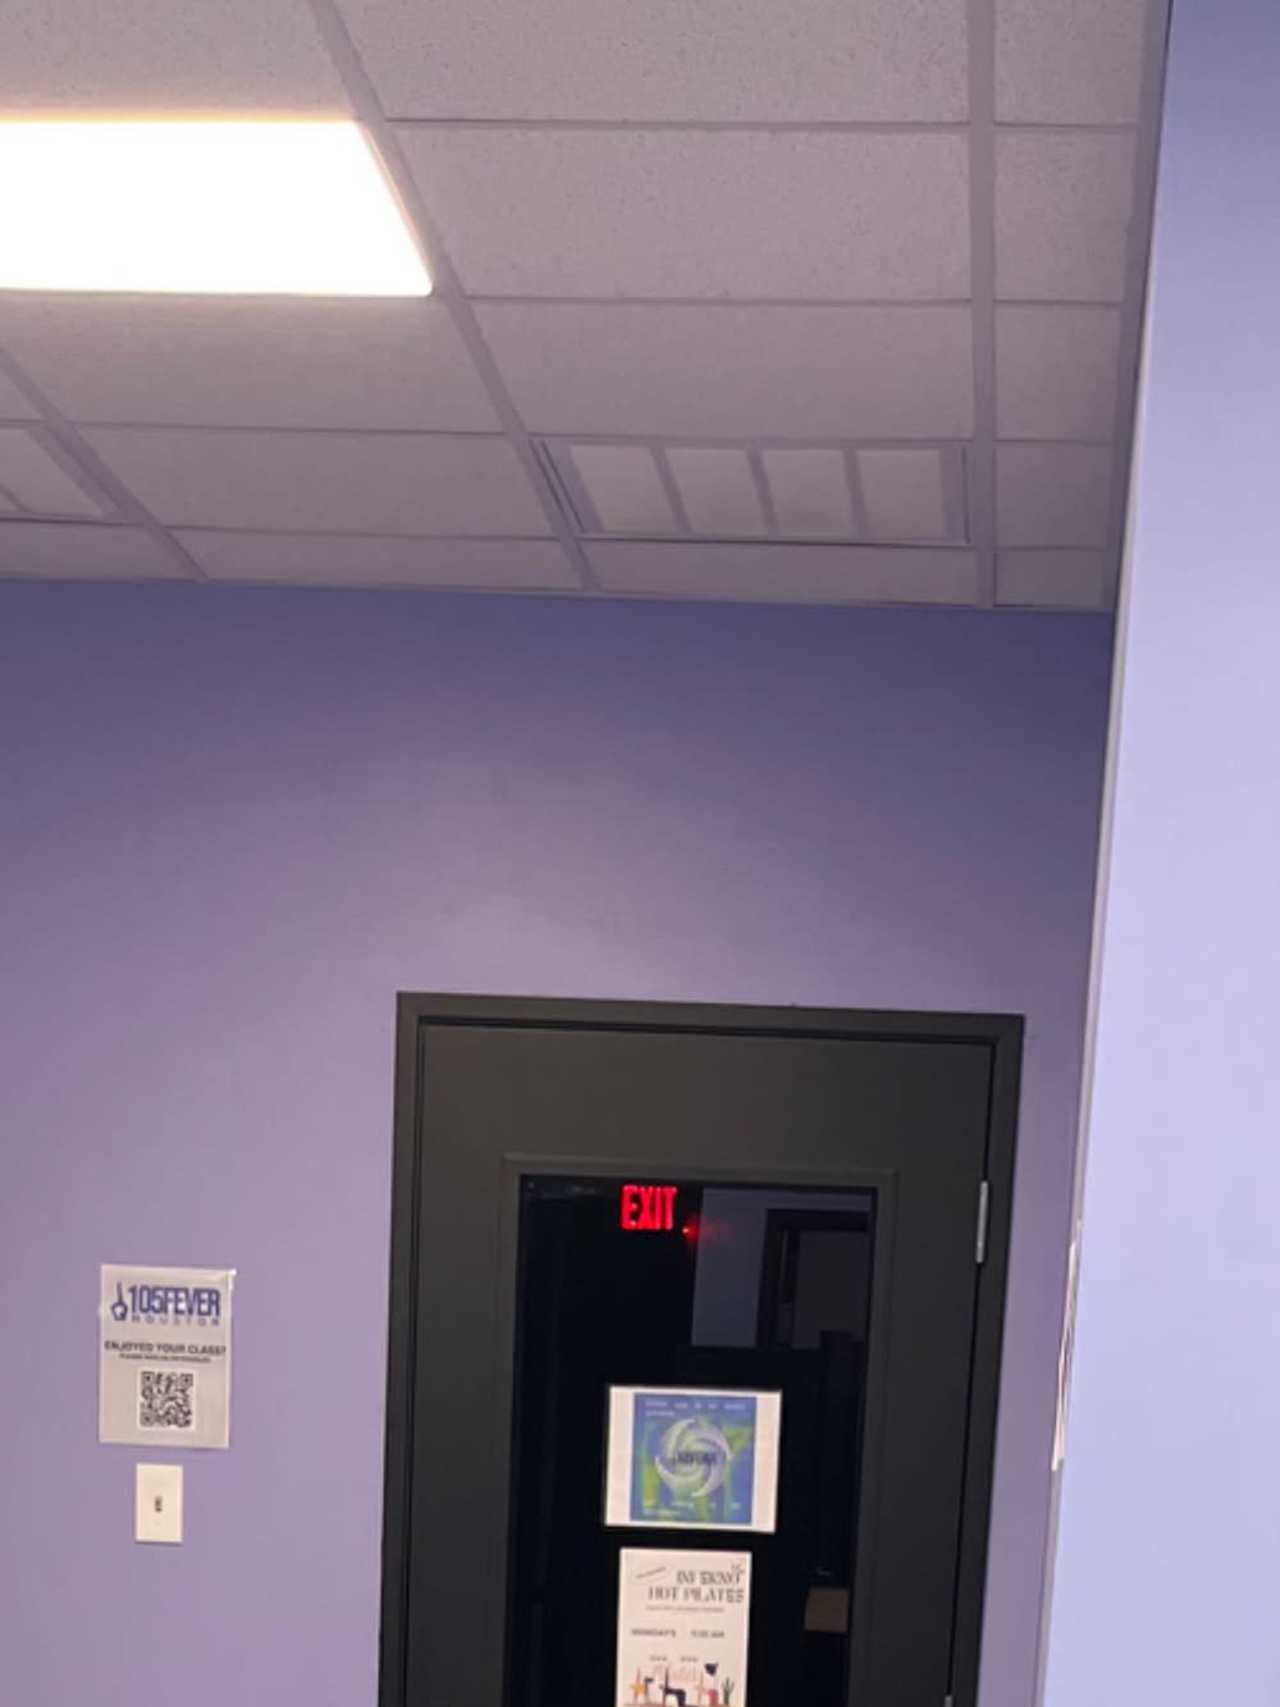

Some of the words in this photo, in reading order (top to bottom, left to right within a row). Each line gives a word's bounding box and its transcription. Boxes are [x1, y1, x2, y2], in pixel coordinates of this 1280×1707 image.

[621, 1182, 677, 1230] EXIT
[128, 1284, 222, 1317] 105FEVER
[104, 1340, 154, 1352] ENJOYED
[156, 1343, 186, 1353] YOUR
[648, 1586, 679, 1601] HOT
[683, 1587, 745, 1604] PILATES
